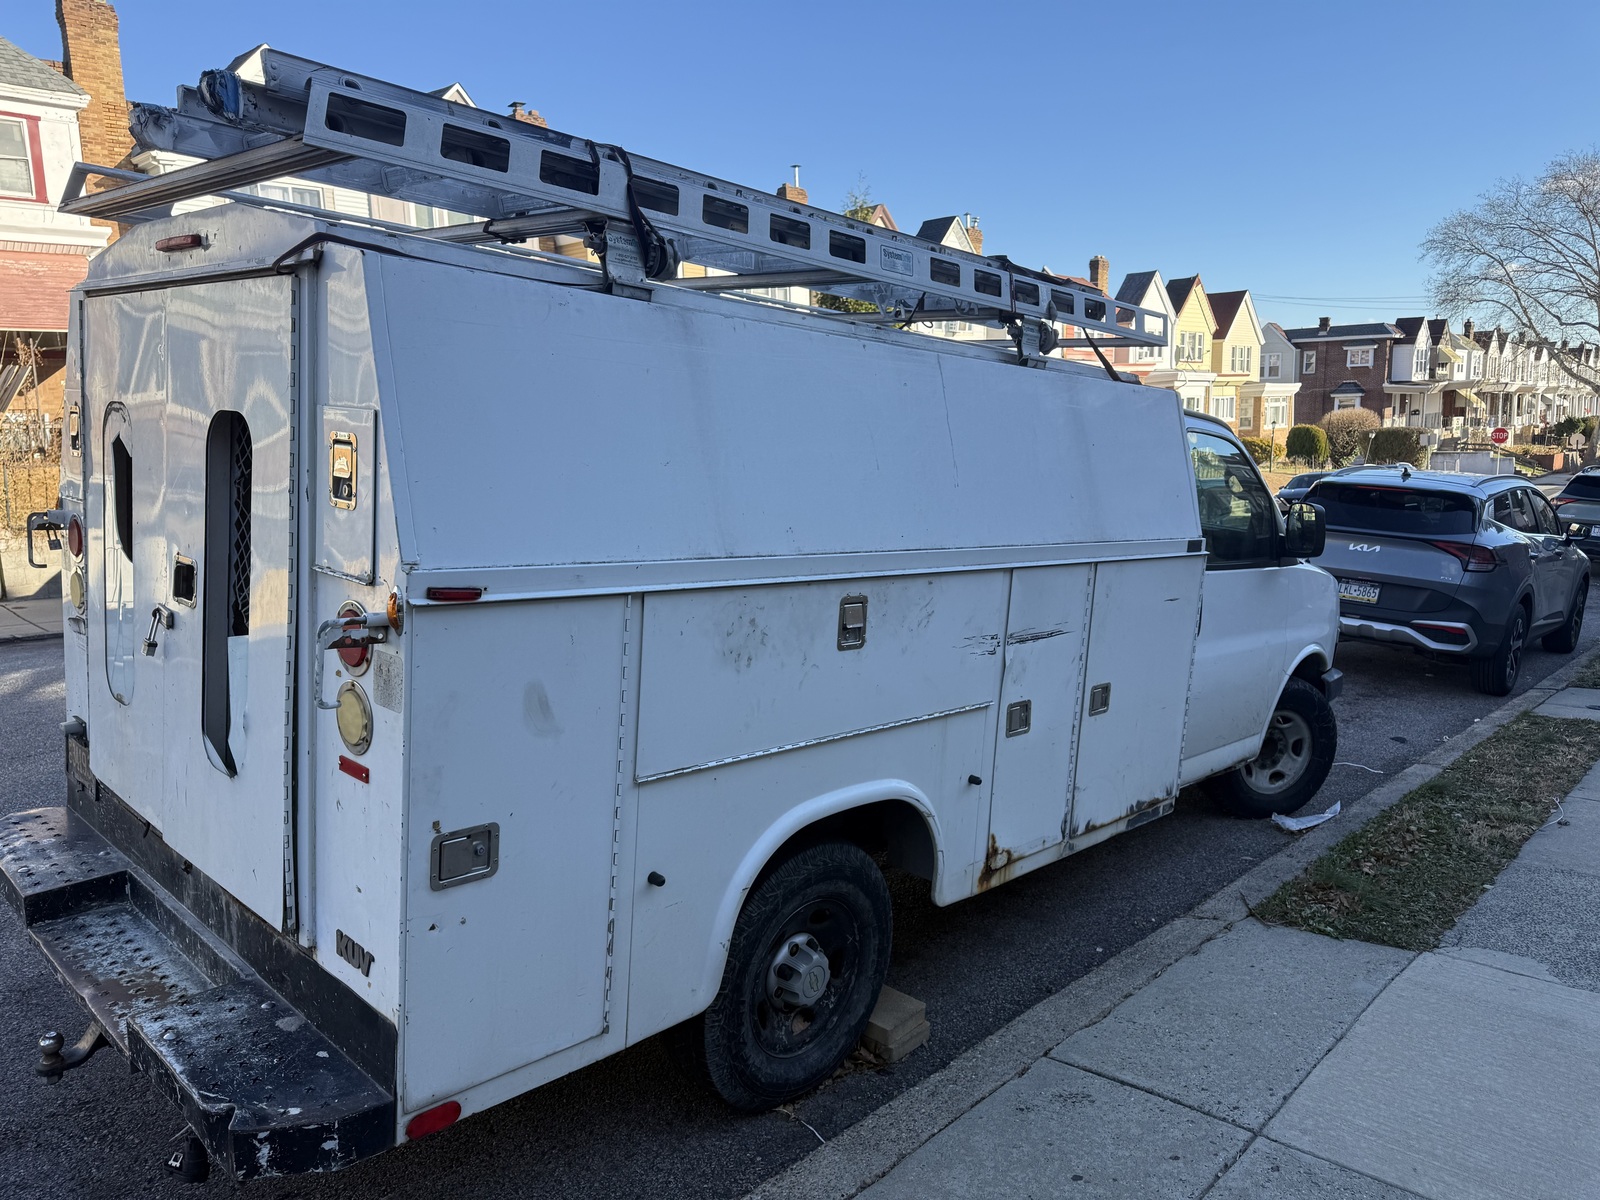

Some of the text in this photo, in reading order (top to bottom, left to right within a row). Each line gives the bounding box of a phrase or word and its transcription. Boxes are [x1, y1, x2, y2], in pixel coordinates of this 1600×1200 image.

[1491, 432, 1508, 440] STOP
[1349, 543, 1380, 552] KIA
[336, 928, 375, 977] KUV
